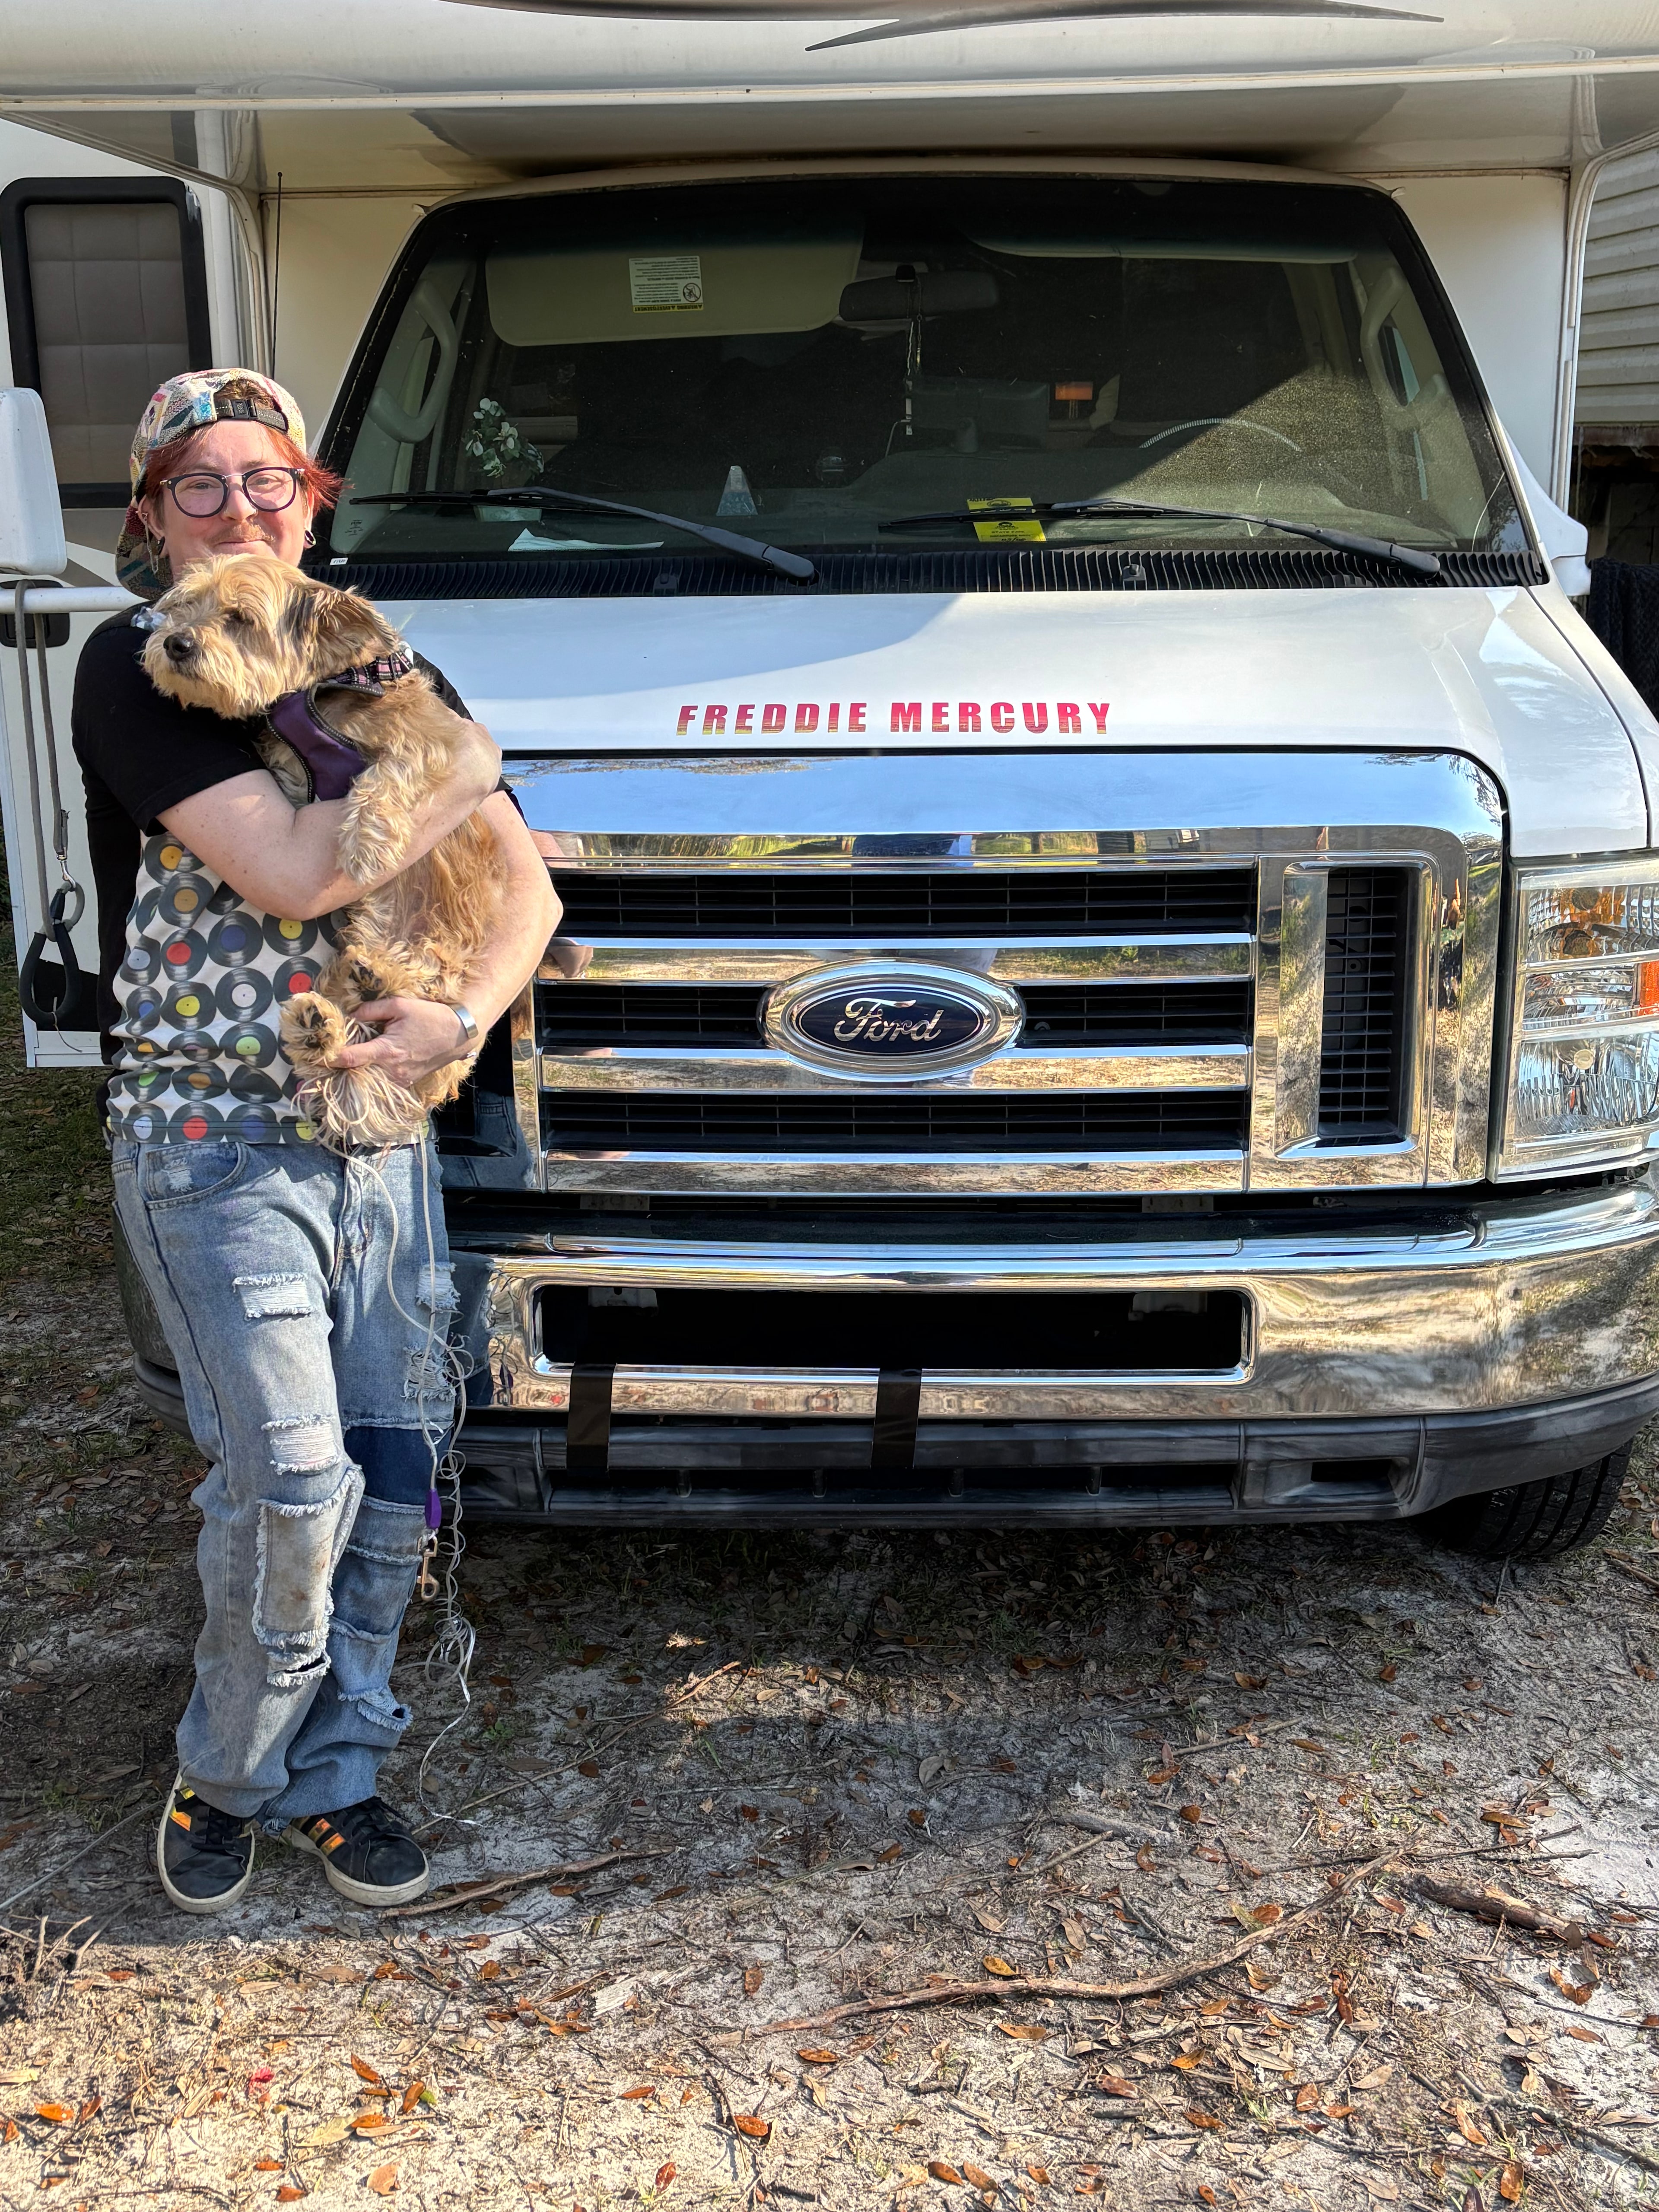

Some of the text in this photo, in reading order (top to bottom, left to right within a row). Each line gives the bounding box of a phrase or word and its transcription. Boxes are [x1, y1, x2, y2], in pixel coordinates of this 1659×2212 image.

[676, 702, 1110, 736] FREDDIE MERCURY
[834, 997, 944, 1042] Ford
